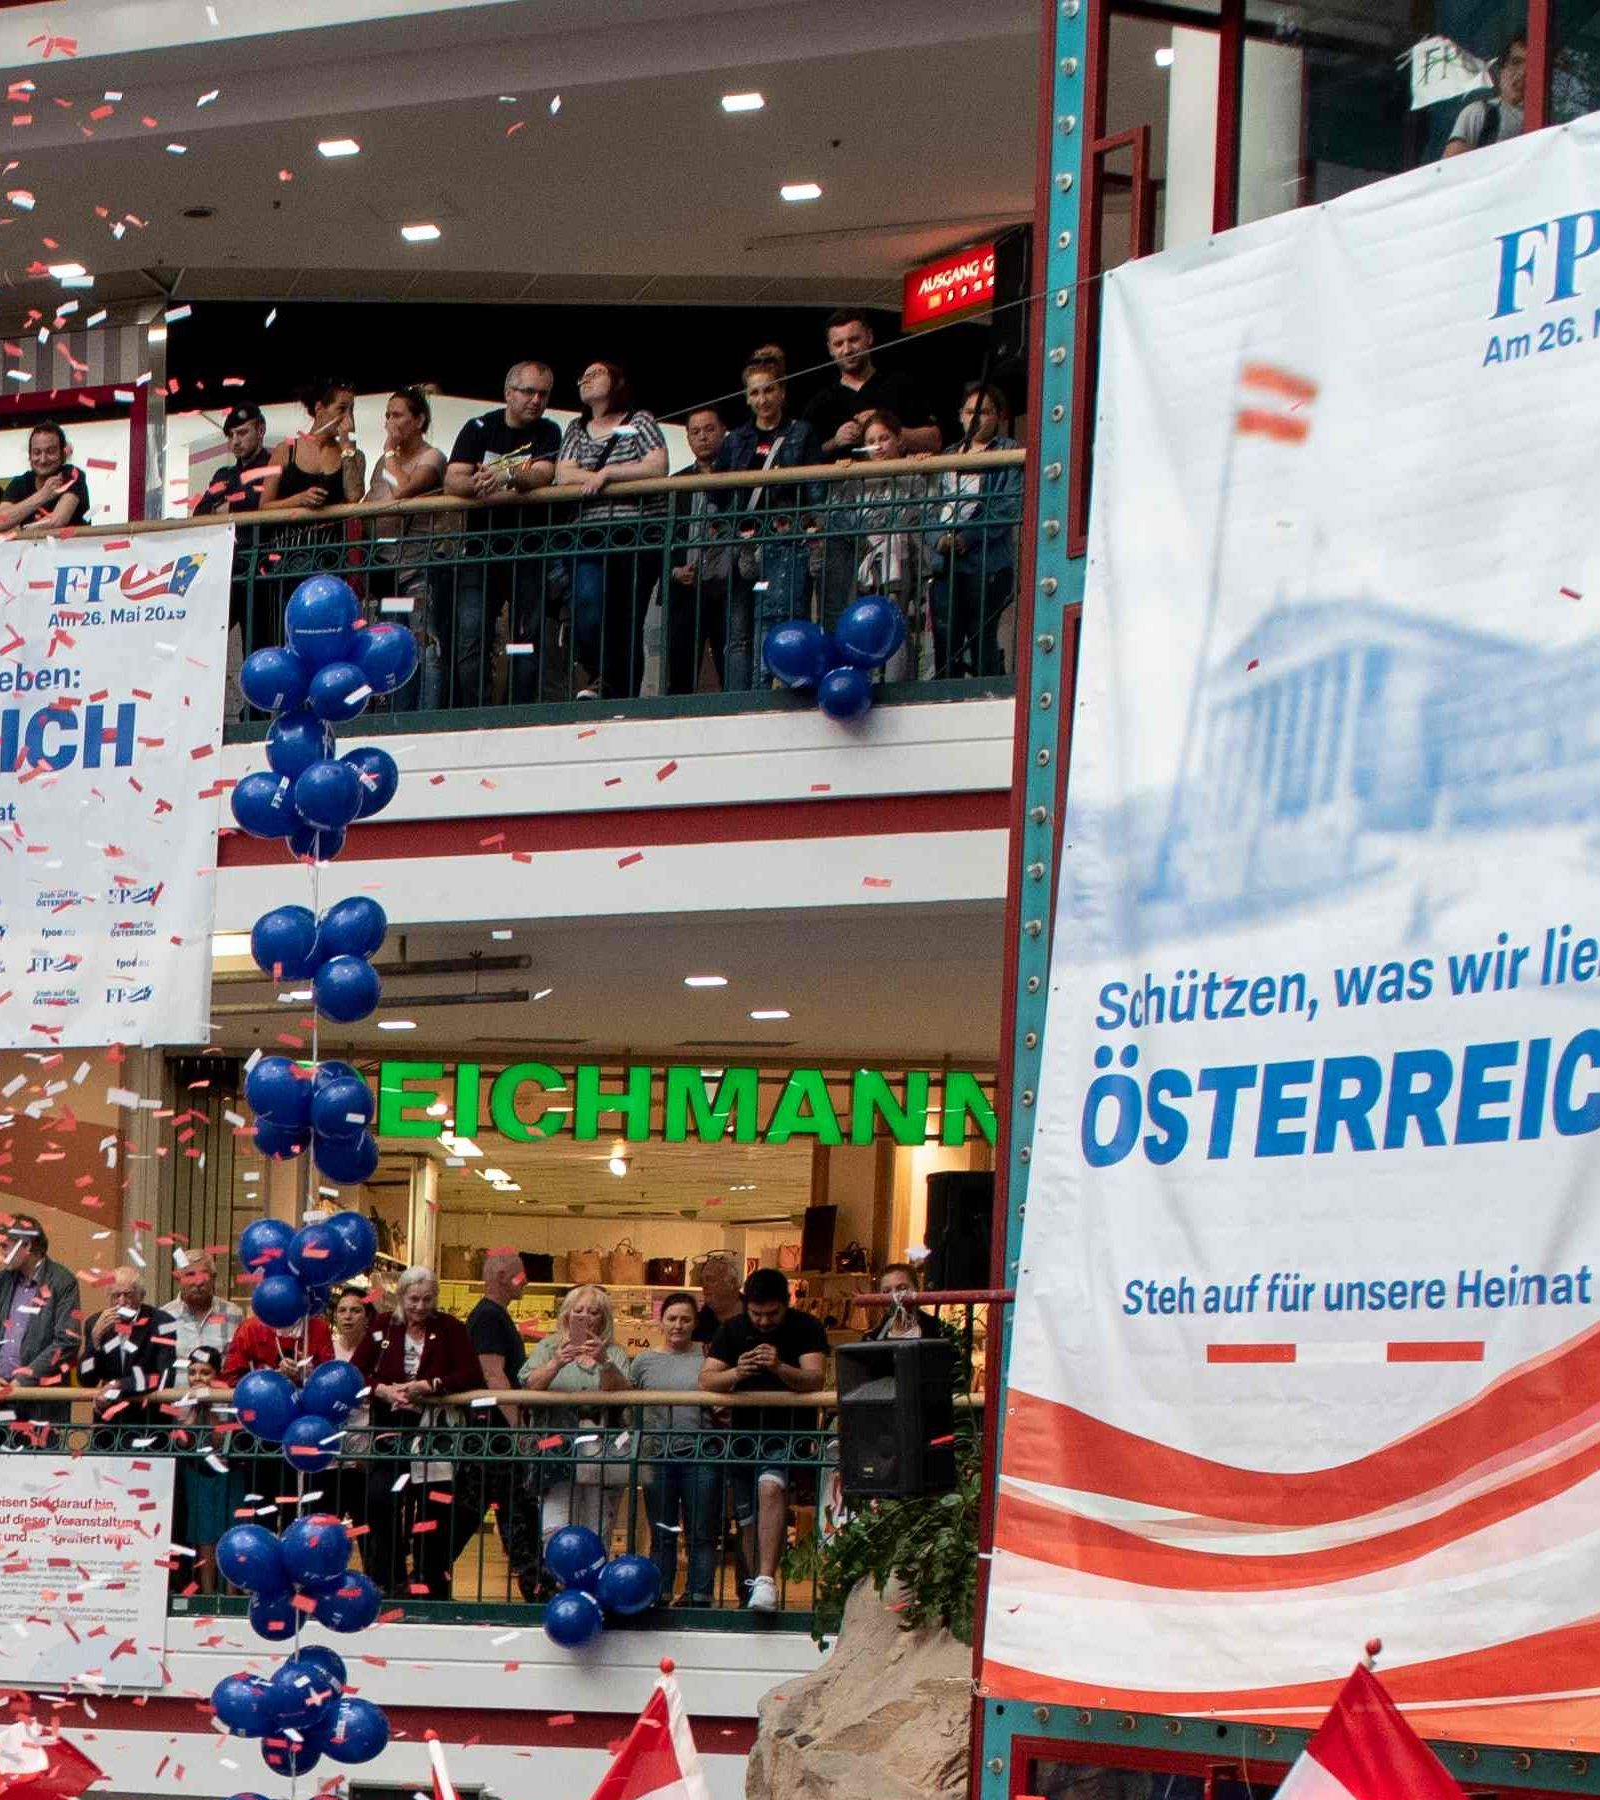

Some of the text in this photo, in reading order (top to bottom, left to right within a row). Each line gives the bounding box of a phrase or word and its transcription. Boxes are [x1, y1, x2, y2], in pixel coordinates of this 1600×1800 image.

[917, 260, 980, 296] AUSGANG
[1483, 333, 1530, 368] Am
[1537, 316, 1583, 353] 26.
[81, 611, 105, 626] 26.
[110, 606, 141, 625] Mai
[1095, 924, 1600, 1032] Schützen, was wir lie
[377, 1061, 999, 1146] EICHMANN
[1123, 1265, 1592, 1315] Steh auf für unsere Heimat
[627, 1338, 650, 1348] FILA
[53, 1498, 92, 1510] darauf
[94, 1500, 117, 1512] hin,
[12, 1514, 50, 1526] dieser
[4, 1532, 27, 1543] und
